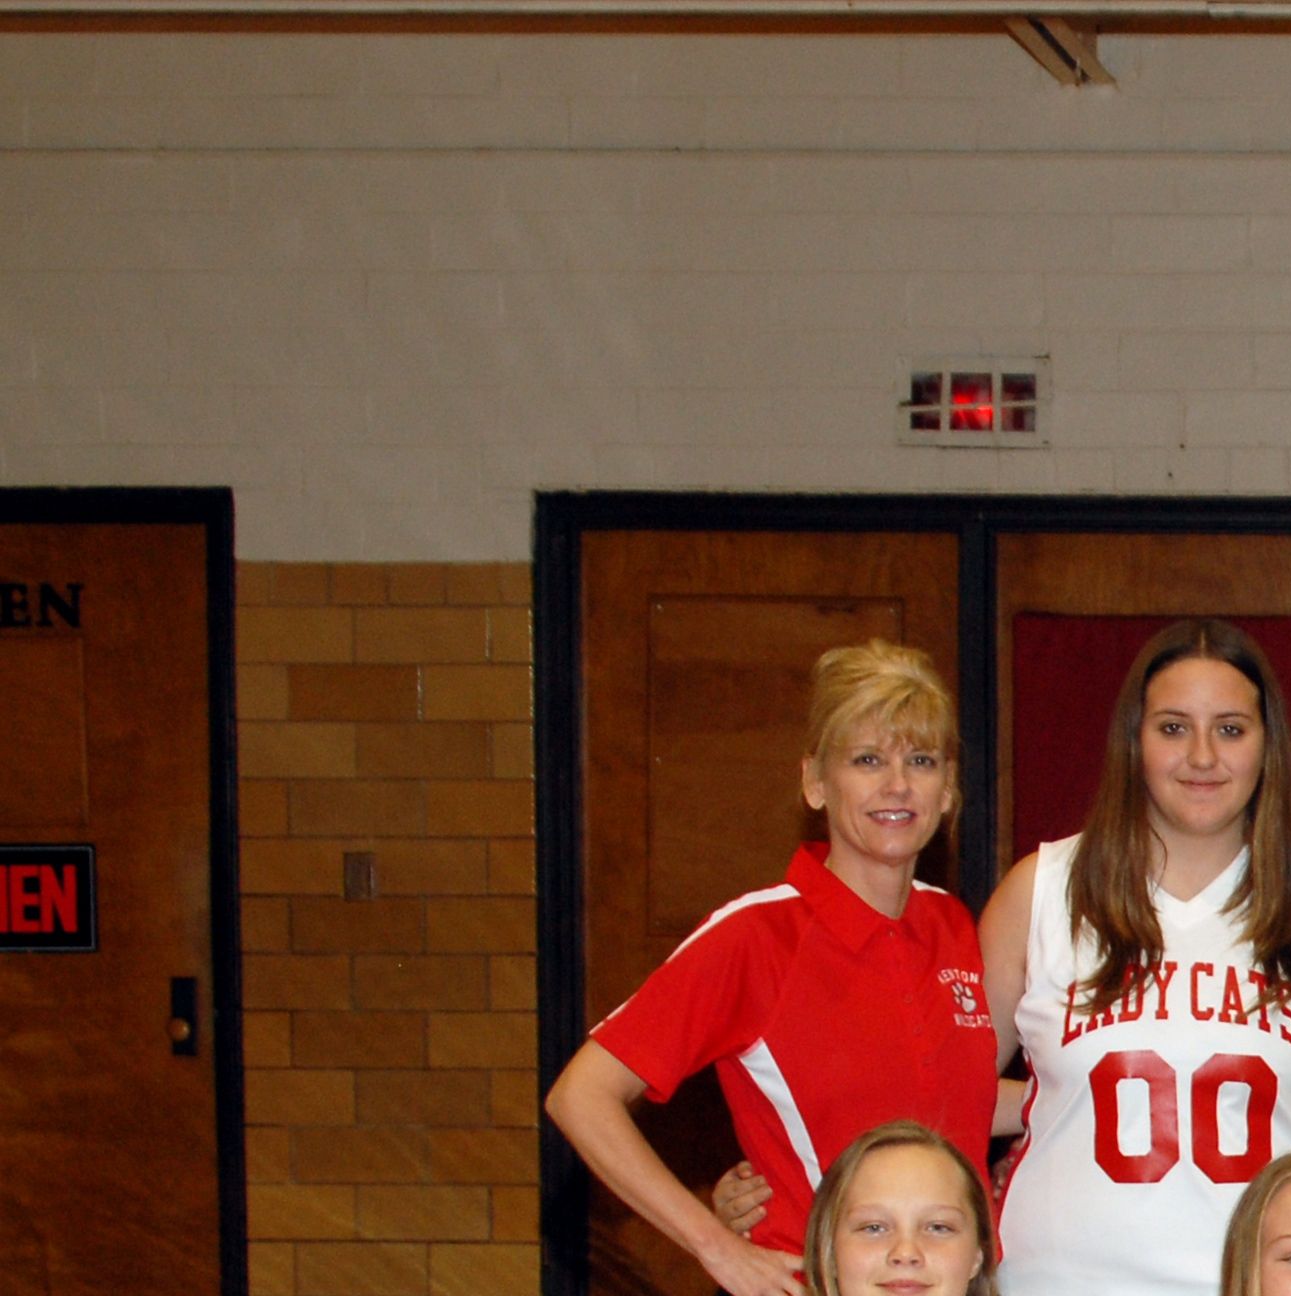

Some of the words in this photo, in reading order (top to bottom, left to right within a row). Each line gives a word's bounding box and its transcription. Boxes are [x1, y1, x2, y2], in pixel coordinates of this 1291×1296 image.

[912, 380, 1036, 430] EXT
[0, 582, 84, 628] EN
[0, 864, 79, 933] EN
[1088, 1049, 1278, 1184] 00
